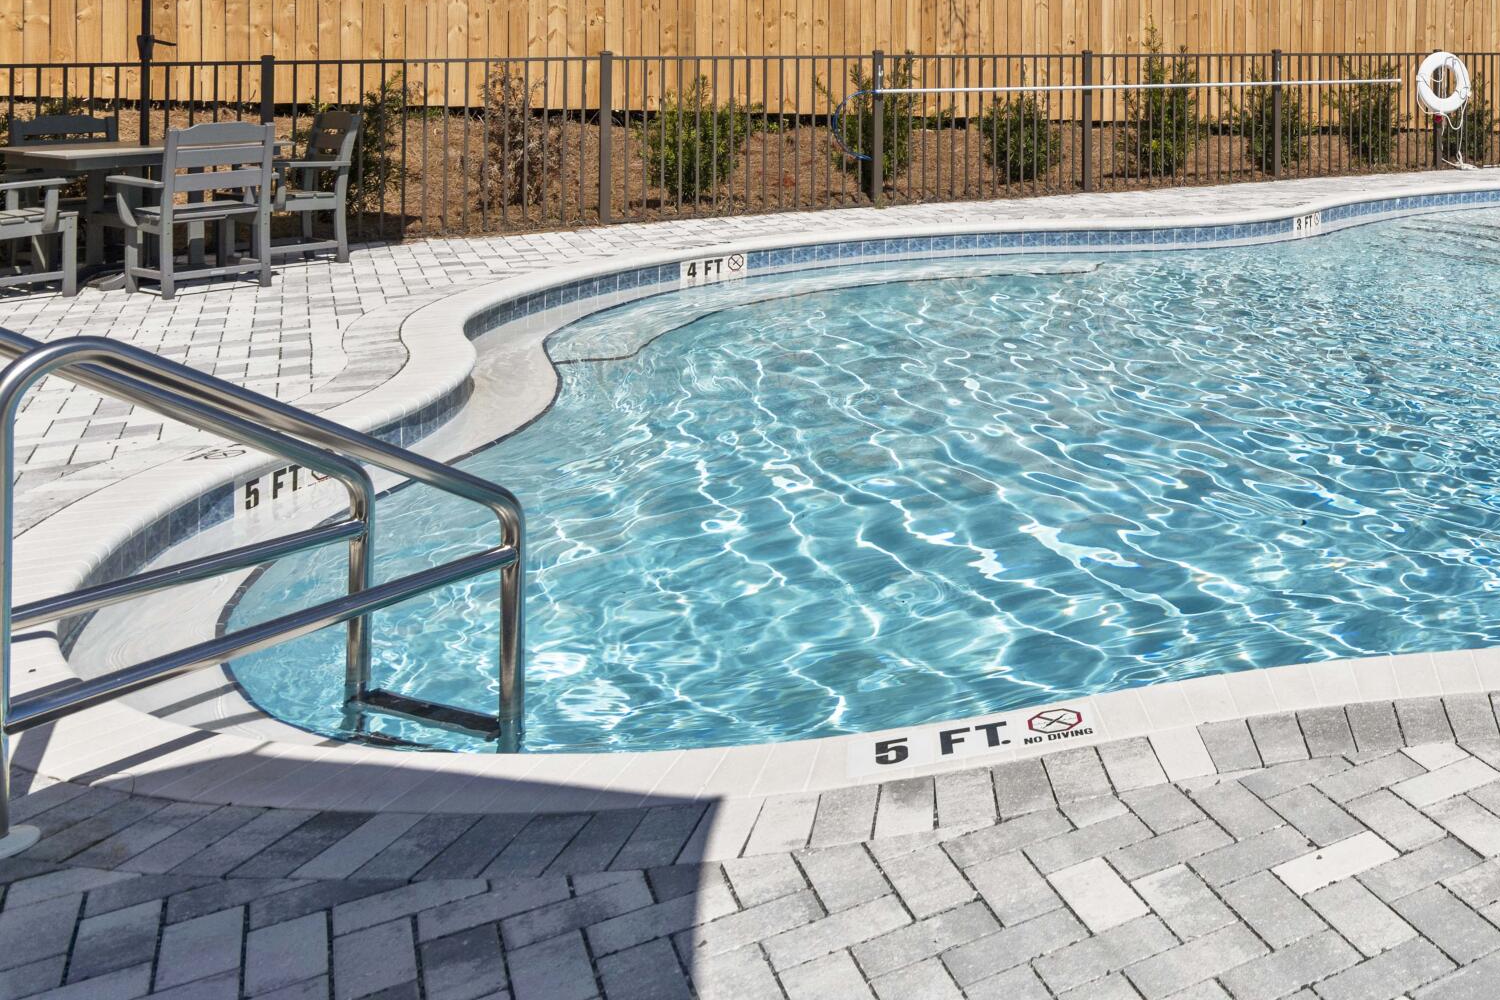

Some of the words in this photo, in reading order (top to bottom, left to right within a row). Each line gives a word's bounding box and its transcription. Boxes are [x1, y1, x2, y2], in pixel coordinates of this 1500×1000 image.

[1297, 218, 1301, 230] 3
[1305, 215, 1312, 229] FT
[687, 262, 697, 277] 4
[704, 258, 723, 275] FT
[246, 477, 259, 510] 5
[875, 738, 909, 765] 5
[939, 721, 1011, 755] FT.
[1024, 736, 1043, 745] NO
[1047, 728, 1093, 741] DIVING
